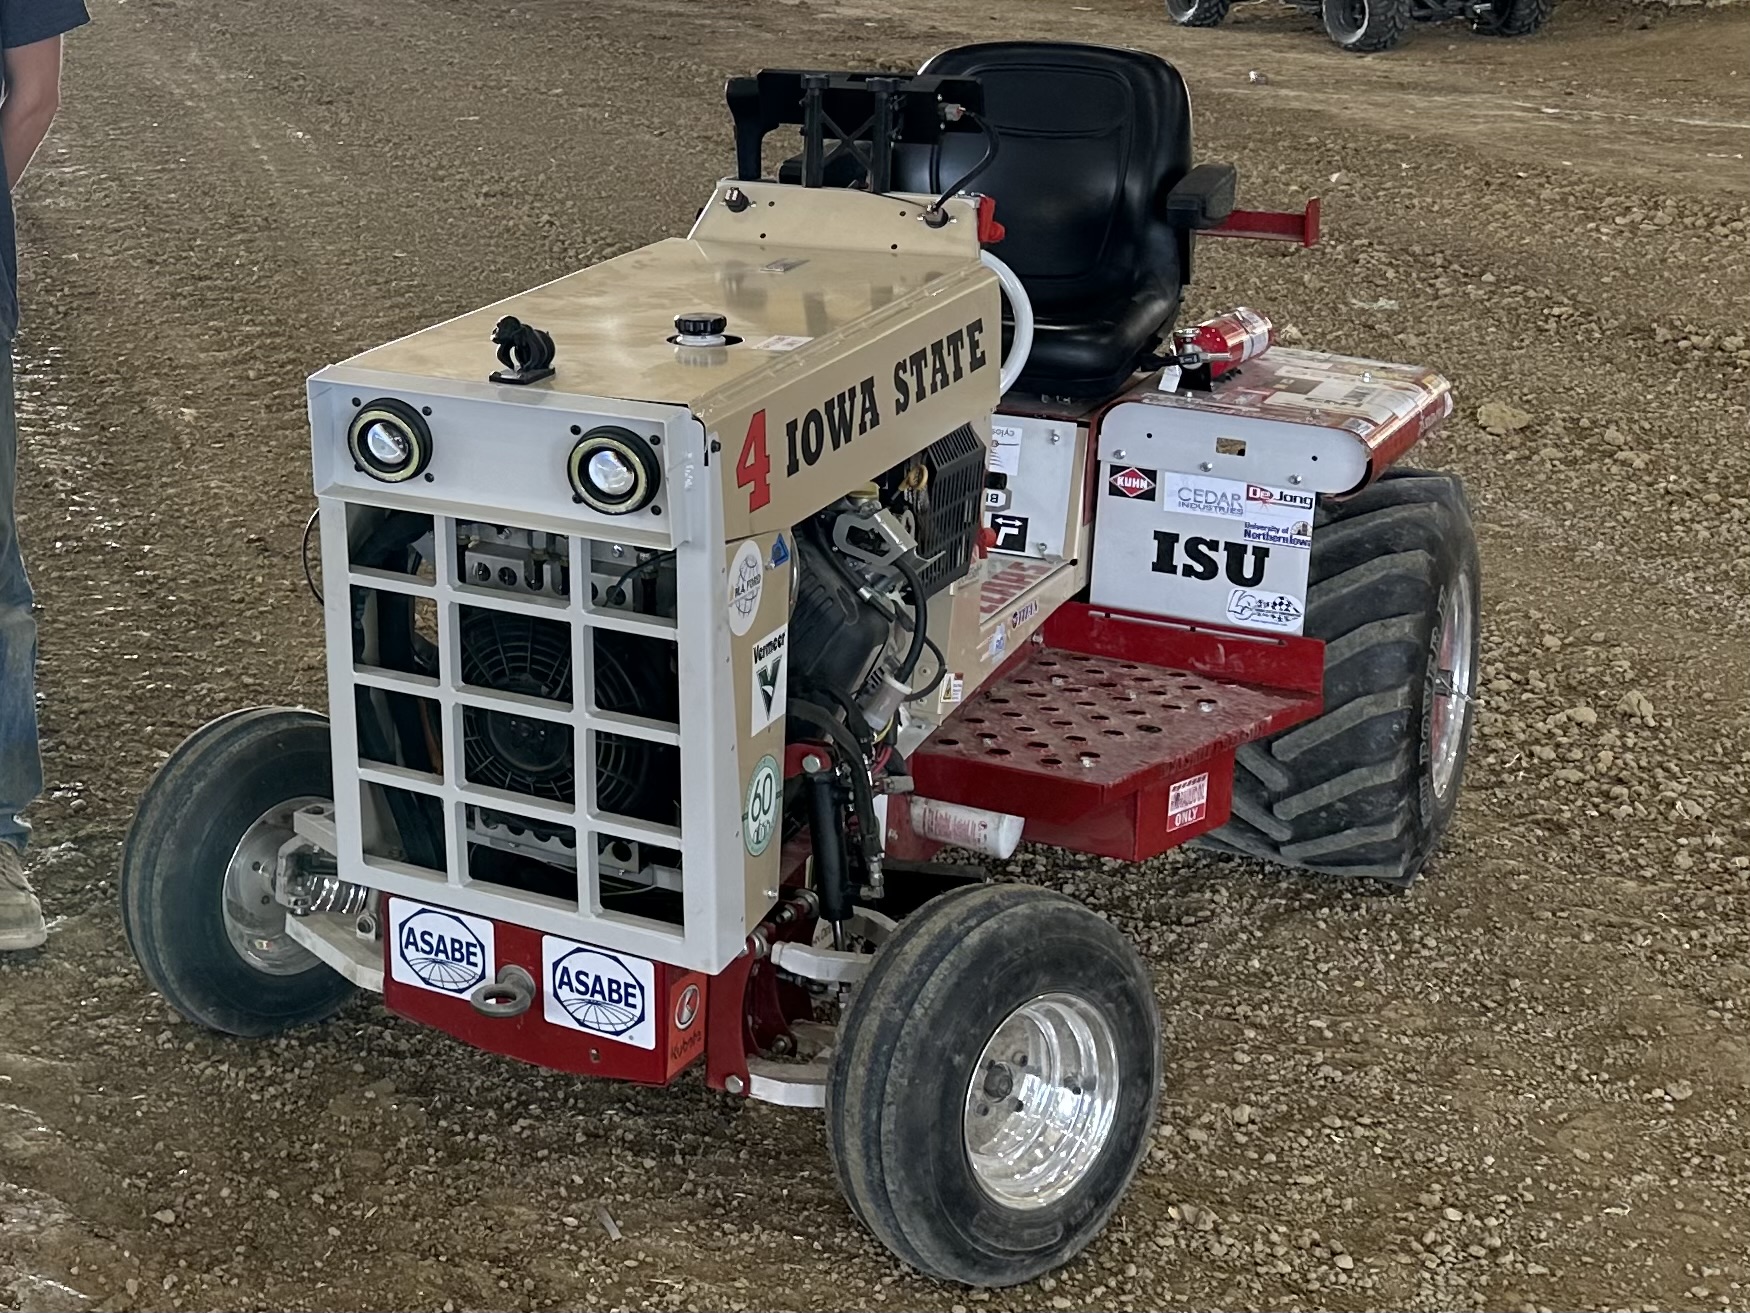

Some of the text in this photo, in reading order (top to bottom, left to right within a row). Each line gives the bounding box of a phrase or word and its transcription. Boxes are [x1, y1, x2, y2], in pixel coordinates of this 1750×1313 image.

[786, 317, 986, 478] IOWA STATE
[736, 409, 771, 513] 4
[1117, 476, 1148, 489] KUHN
[1178, 487, 1243, 509] CEDAR
[1178, 501, 1244, 515] INDUSTRIES
[1244, 521, 1289, 535] University of
[1244, 529, 1311, 547] Northern Iowa
[1152, 529, 1270, 588] ISU
[753, 631, 786, 664] Vermeer
[1419, 626, 1440, 765] POWER
[751, 772, 773, 822] 60
[1174, 806, 1198, 827] ONLY
[404, 926, 479, 968] ASABE
[557, 966, 638, 1010] ASABE
[671, 1030, 702, 1060] Kubota
